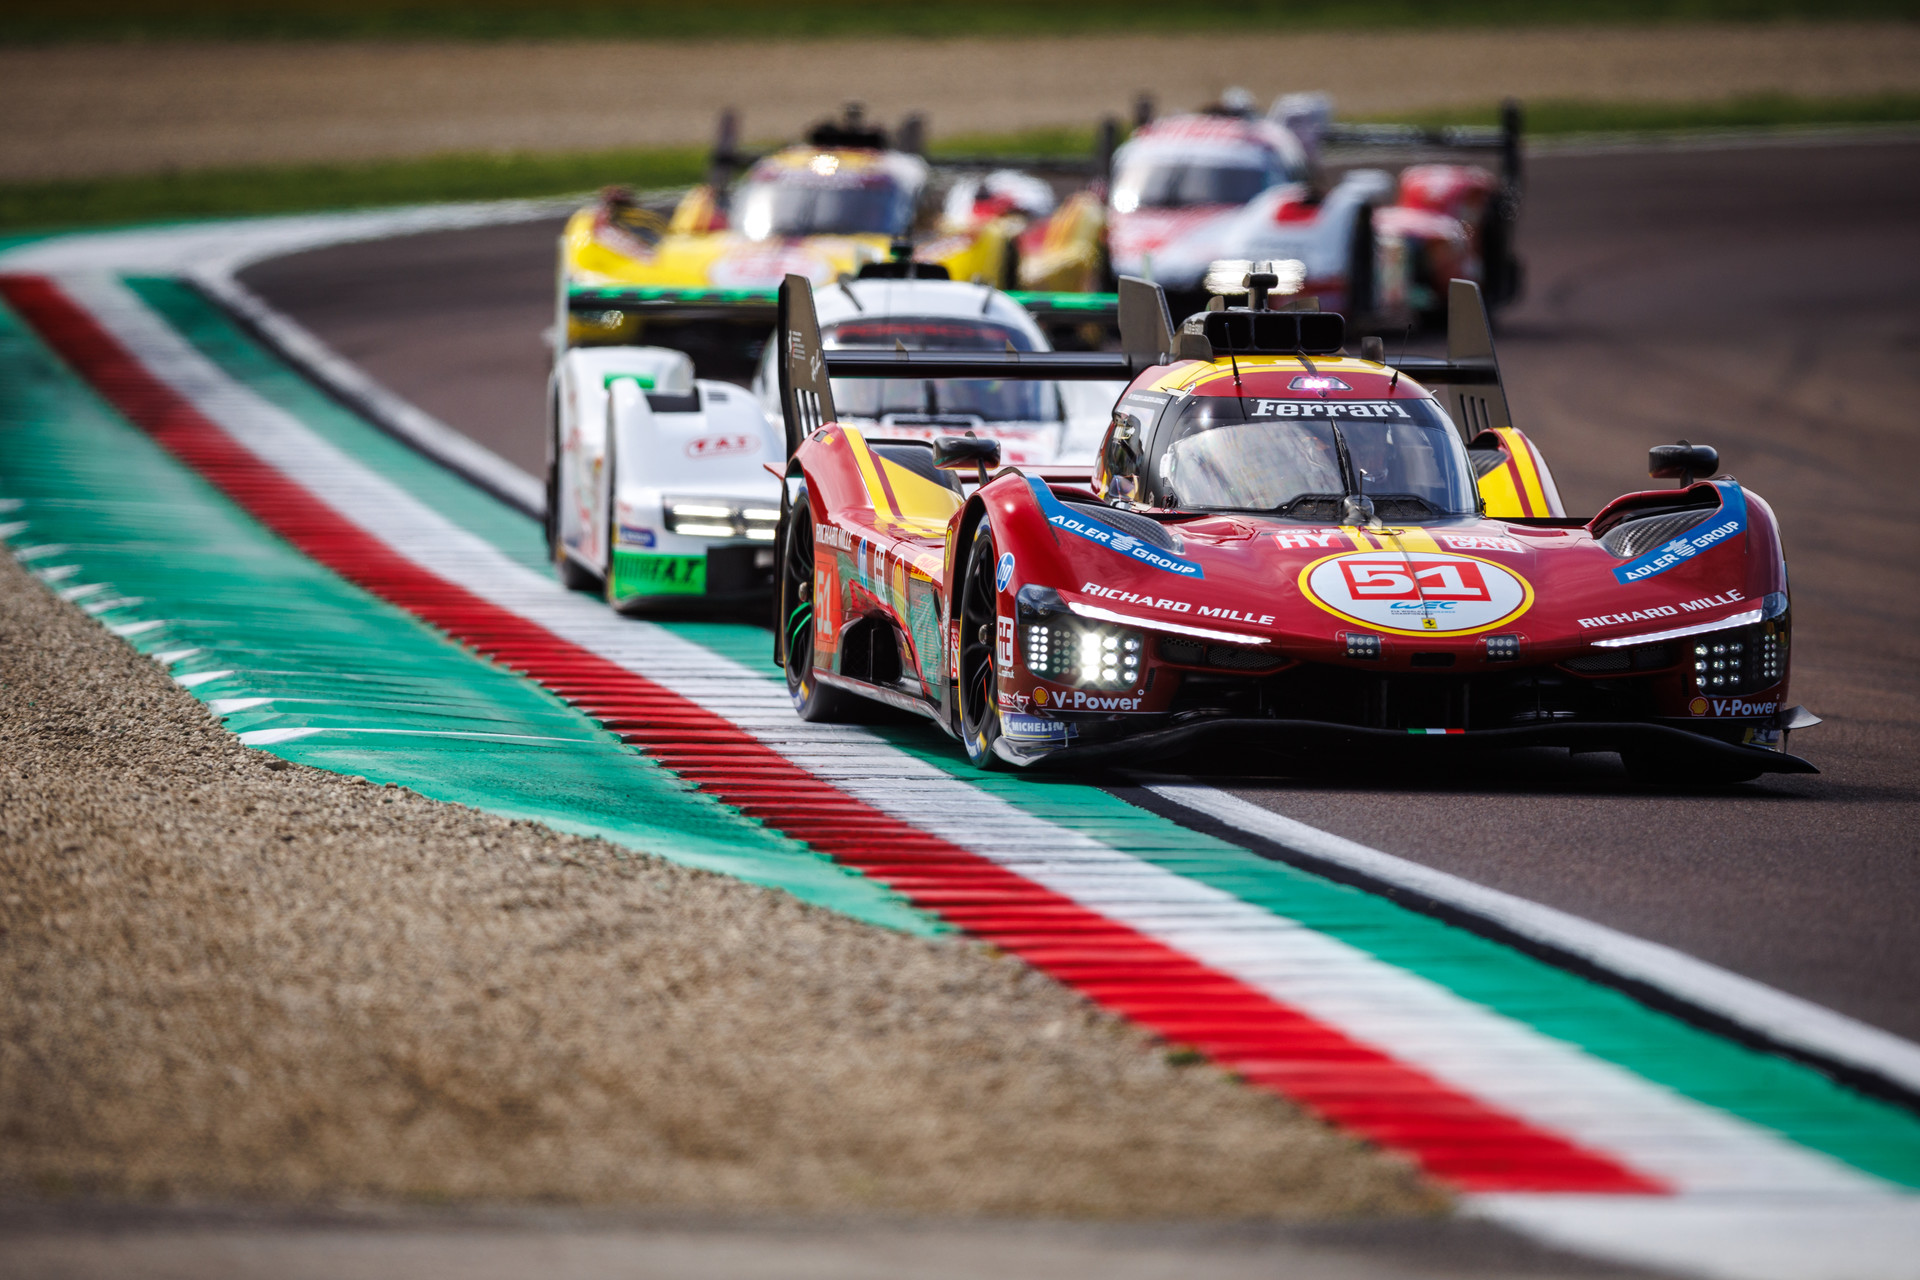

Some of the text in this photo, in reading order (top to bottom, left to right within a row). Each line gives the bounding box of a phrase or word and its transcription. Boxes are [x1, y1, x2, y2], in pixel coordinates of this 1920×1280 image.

[1251, 399, 1411, 418] Ferrari
[1049, 514, 1197, 575] ADLER GROUP
[1276, 534, 1331, 549] HY
[1451, 540, 1518, 551] CAR
[1625, 521, 1740, 580] ADLER GROUP
[997, 555, 1013, 590] hp
[1348, 564, 1482, 596] 51
[815, 570, 832, 636] 51
[1080, 582, 1276, 625] RICHARD MILLE
[1390, 601, 1458, 610] WEC
[1577, 589, 1745, 628] RICHARD MILLE
[1052, 691, 1142, 710] V-Power
[1712, 700, 1777, 716] V-Power
[1011, 721, 1065, 732] MICHELIN
